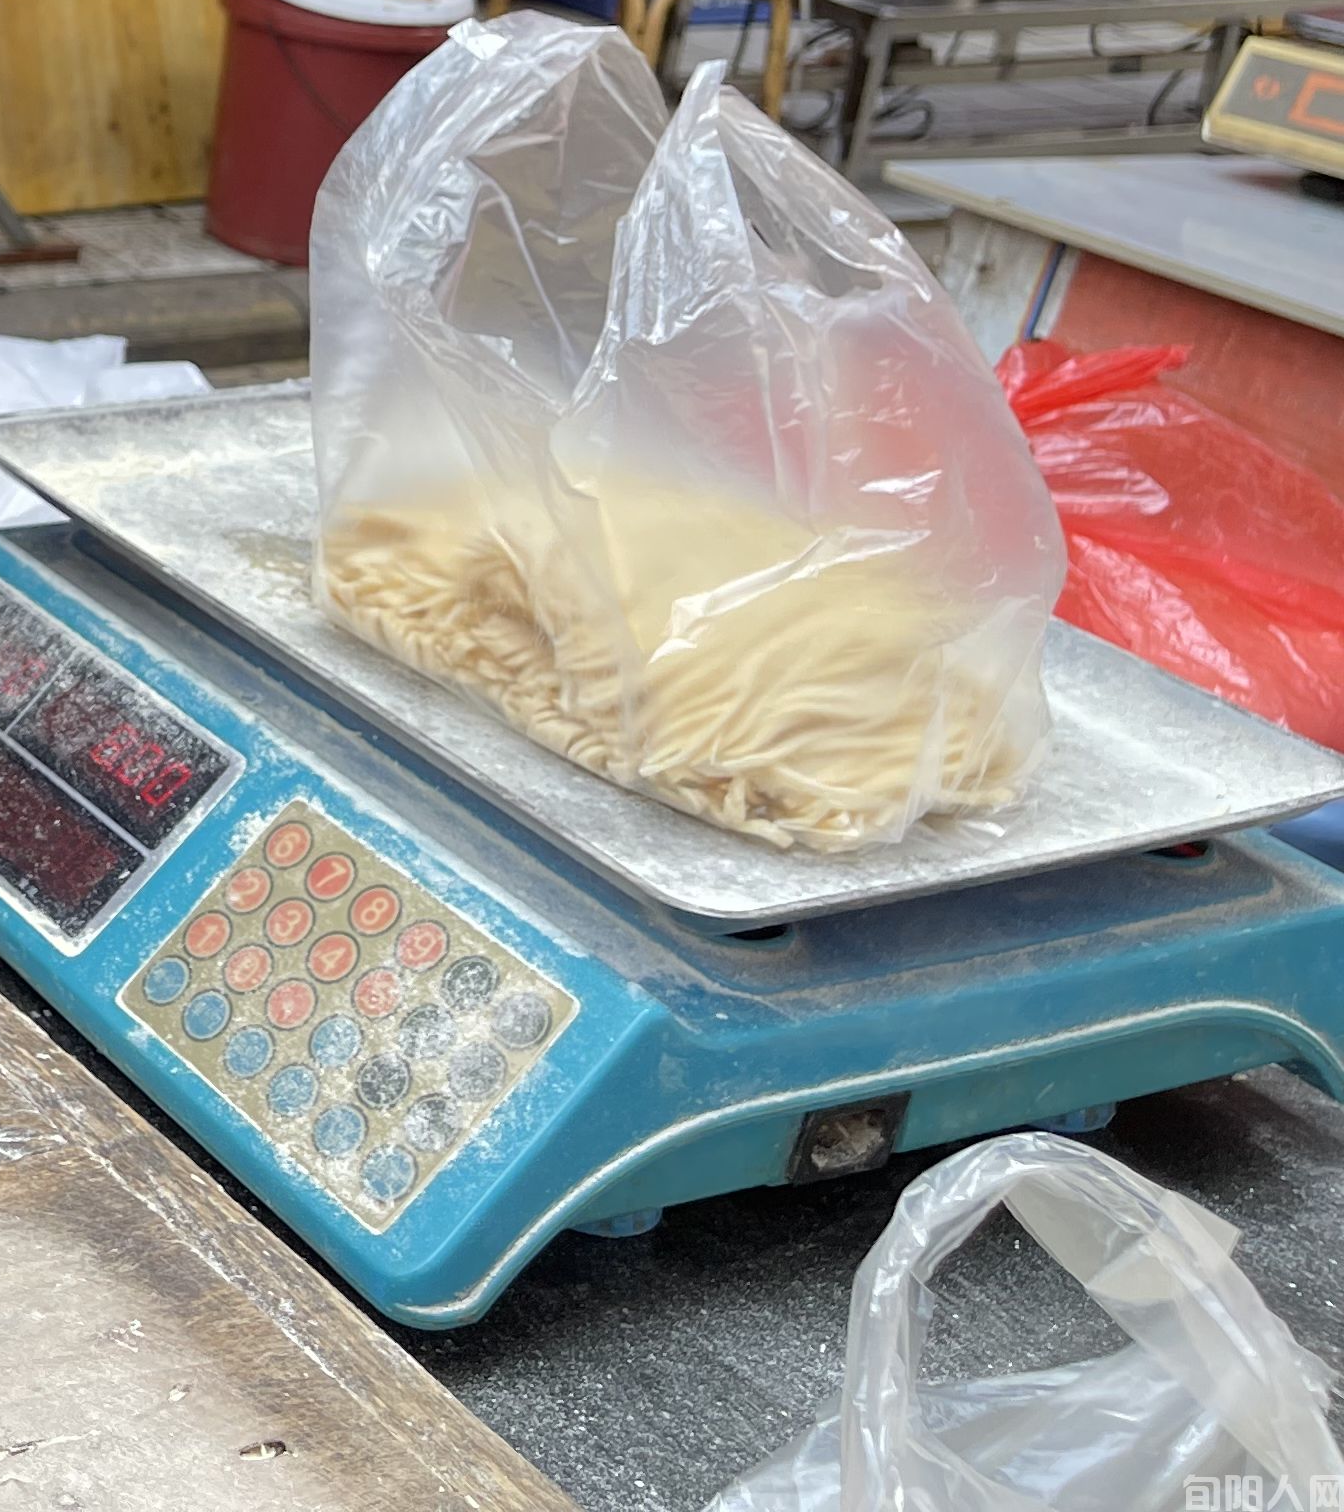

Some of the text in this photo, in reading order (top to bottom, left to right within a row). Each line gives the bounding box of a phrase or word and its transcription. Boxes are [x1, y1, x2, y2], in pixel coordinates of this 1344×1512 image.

[274, 909, 302, 938] 3
[318, 947, 348, 974] 4
[276, 831, 438, 961] 6 7 8 9
